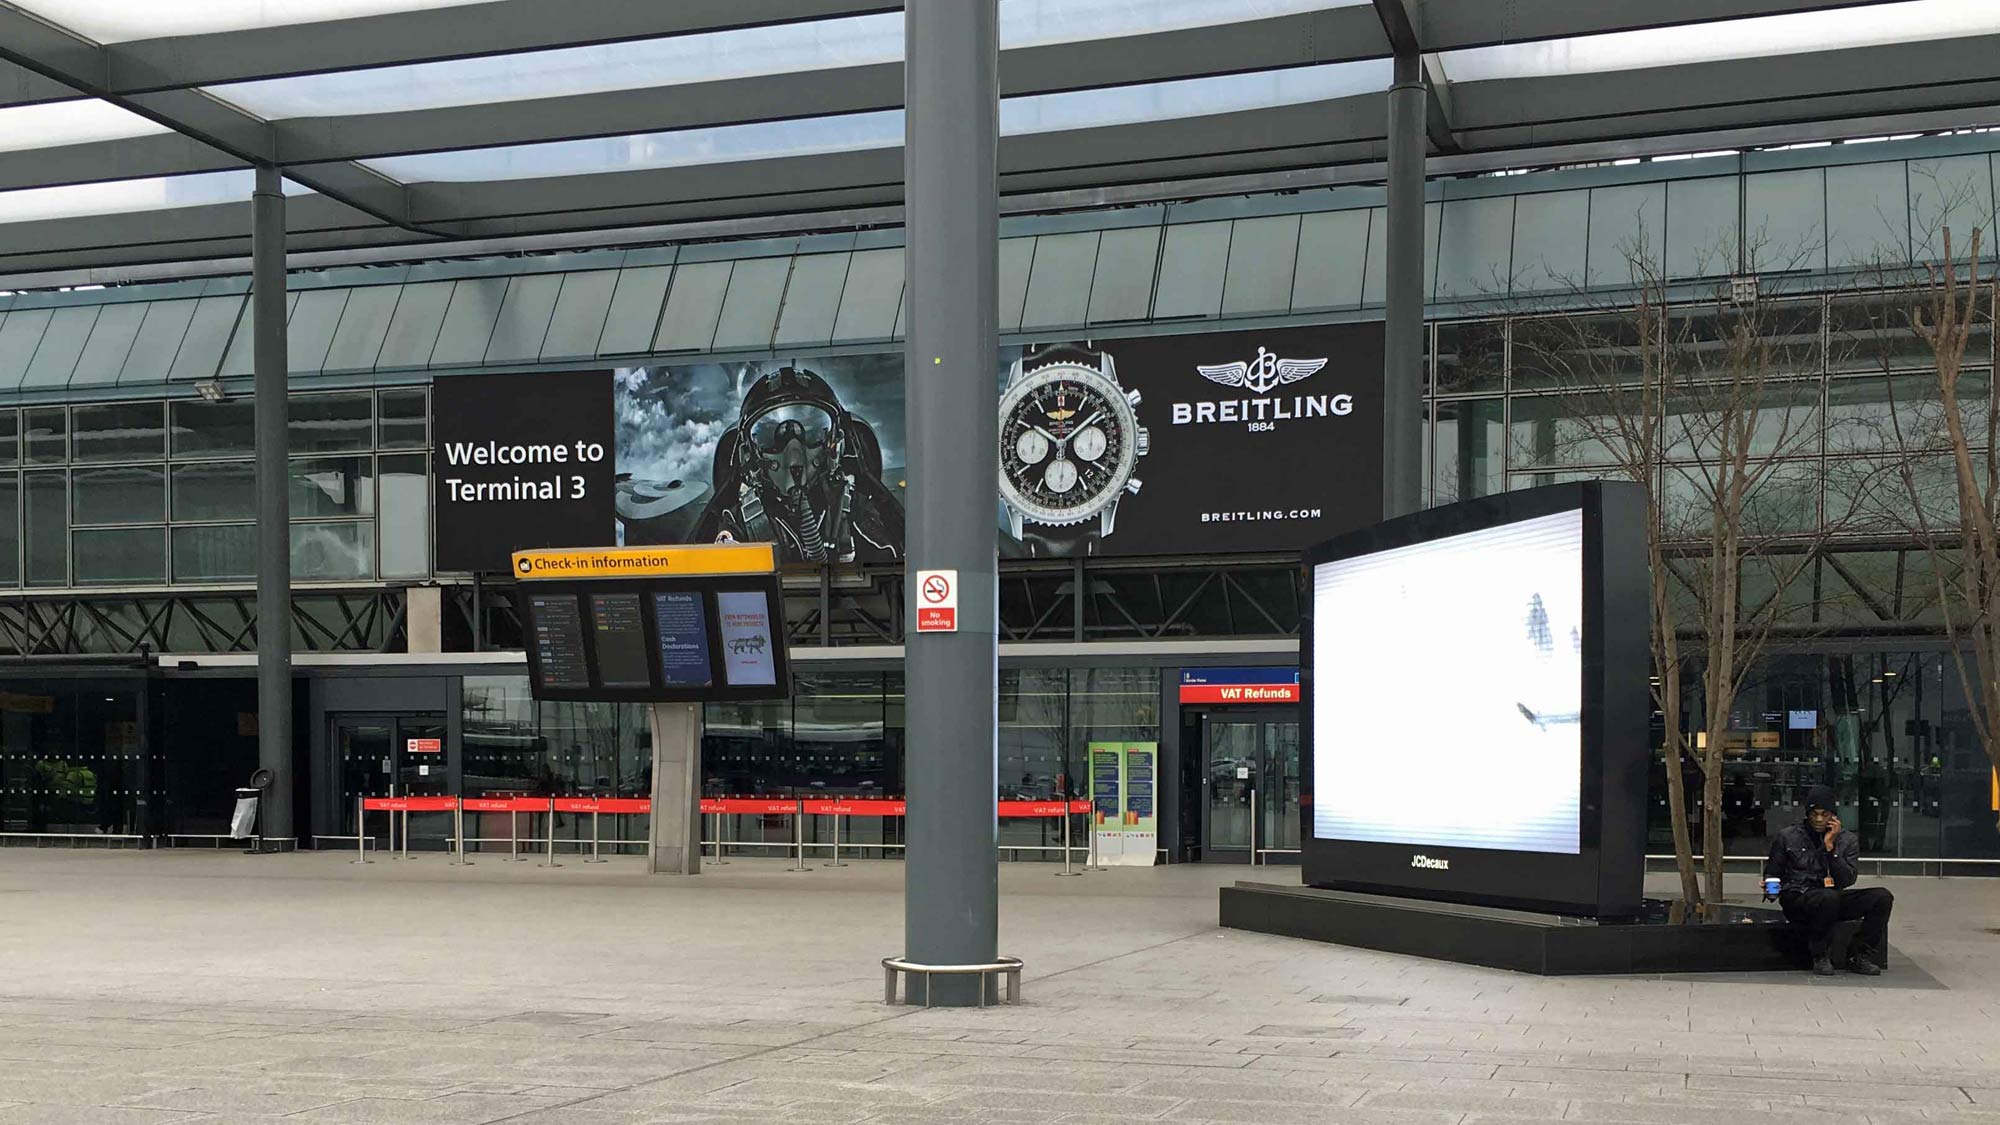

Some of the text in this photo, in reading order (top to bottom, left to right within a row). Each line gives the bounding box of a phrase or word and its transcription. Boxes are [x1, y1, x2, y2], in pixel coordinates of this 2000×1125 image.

[1172, 394, 1353, 424] BREITLING
[1248, 422, 1275, 432] 1884
[445, 440, 604, 465] Welcome to
[1084, 468, 1094, 479] 12
[445, 475, 586, 501] Terminal 3
[1201, 509, 1321, 522] BREITLING.COM
[534, 555, 668, 569] Check-in information
[929, 611, 940, 619] No
[921, 618, 951, 628] smoking
[1221, 688, 1291, 699] VAT Refunds
[1411, 854, 1449, 870] JCDecaux
